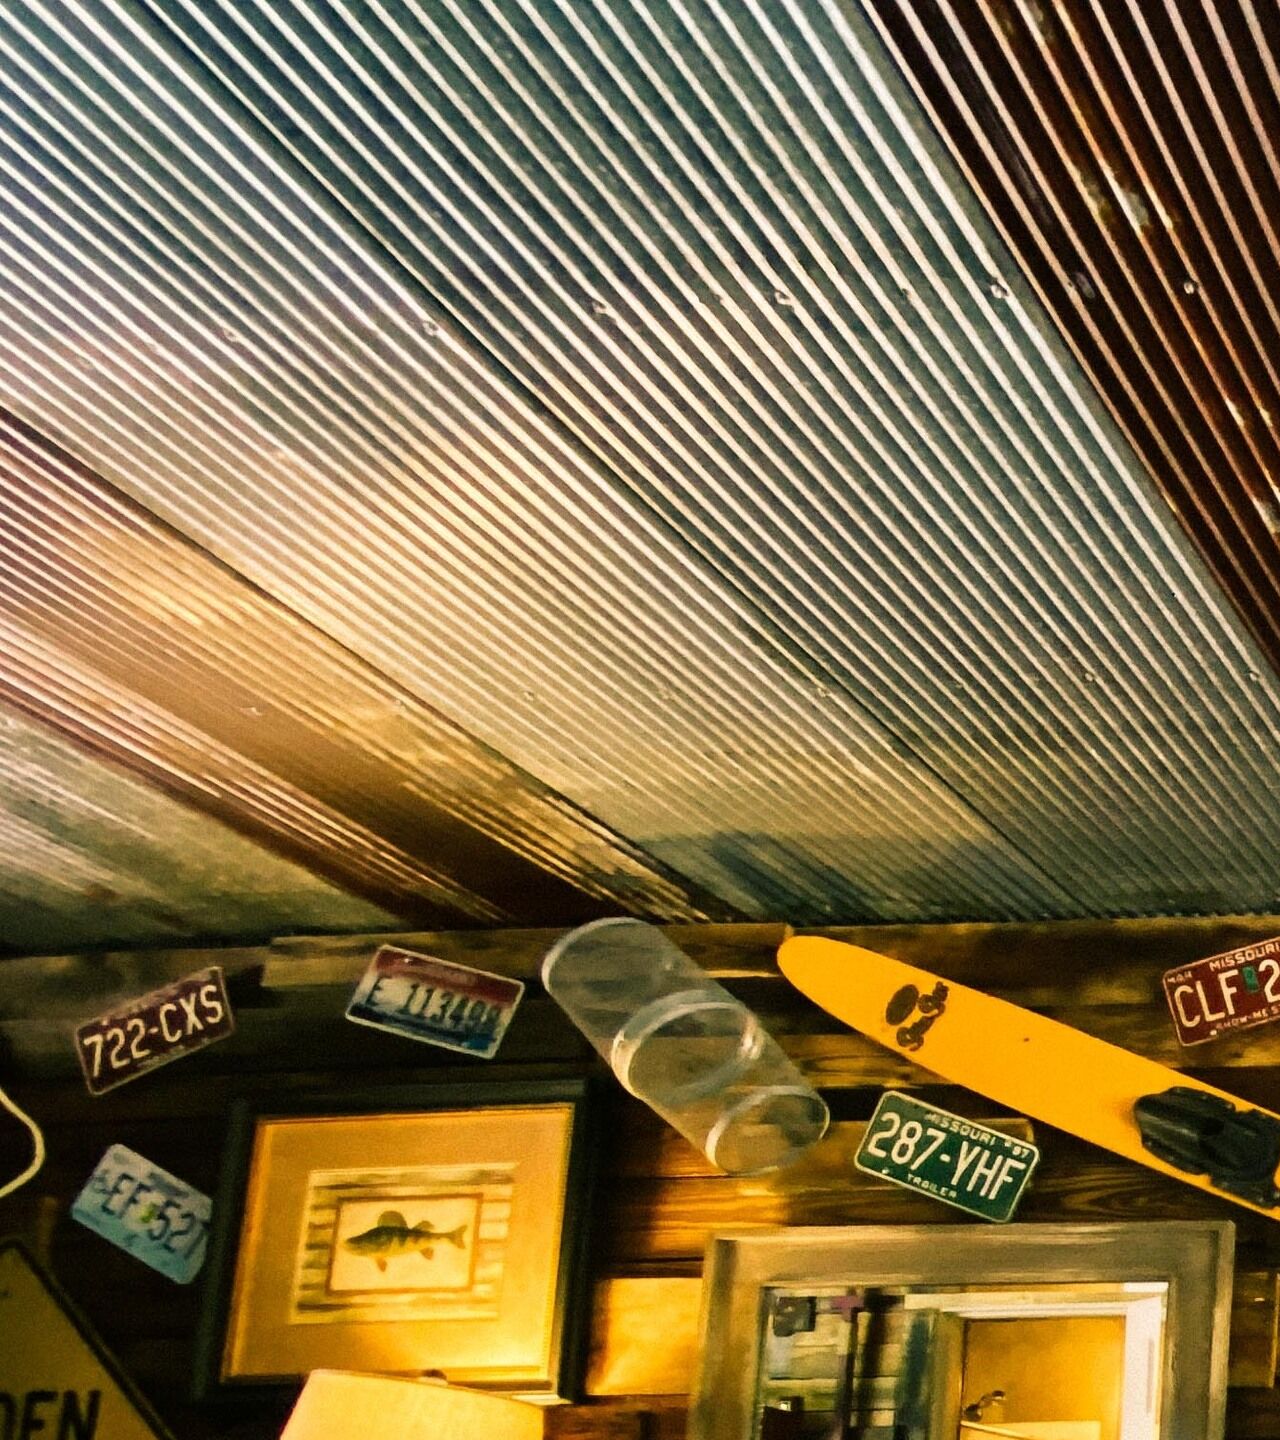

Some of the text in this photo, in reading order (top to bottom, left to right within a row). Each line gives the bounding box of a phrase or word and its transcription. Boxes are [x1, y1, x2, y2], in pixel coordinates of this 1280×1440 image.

[1209, 941, 1280, 972] MISSOURI
[1173, 968, 1239, 1028] CLF
[83, 984, 224, 1078] 722-CXS
[923, 1112, 997, 1147] MISSOURI
[867, 1111, 1028, 1201] 287-YHF
[907, 1173, 958, 1199] TRAILER
